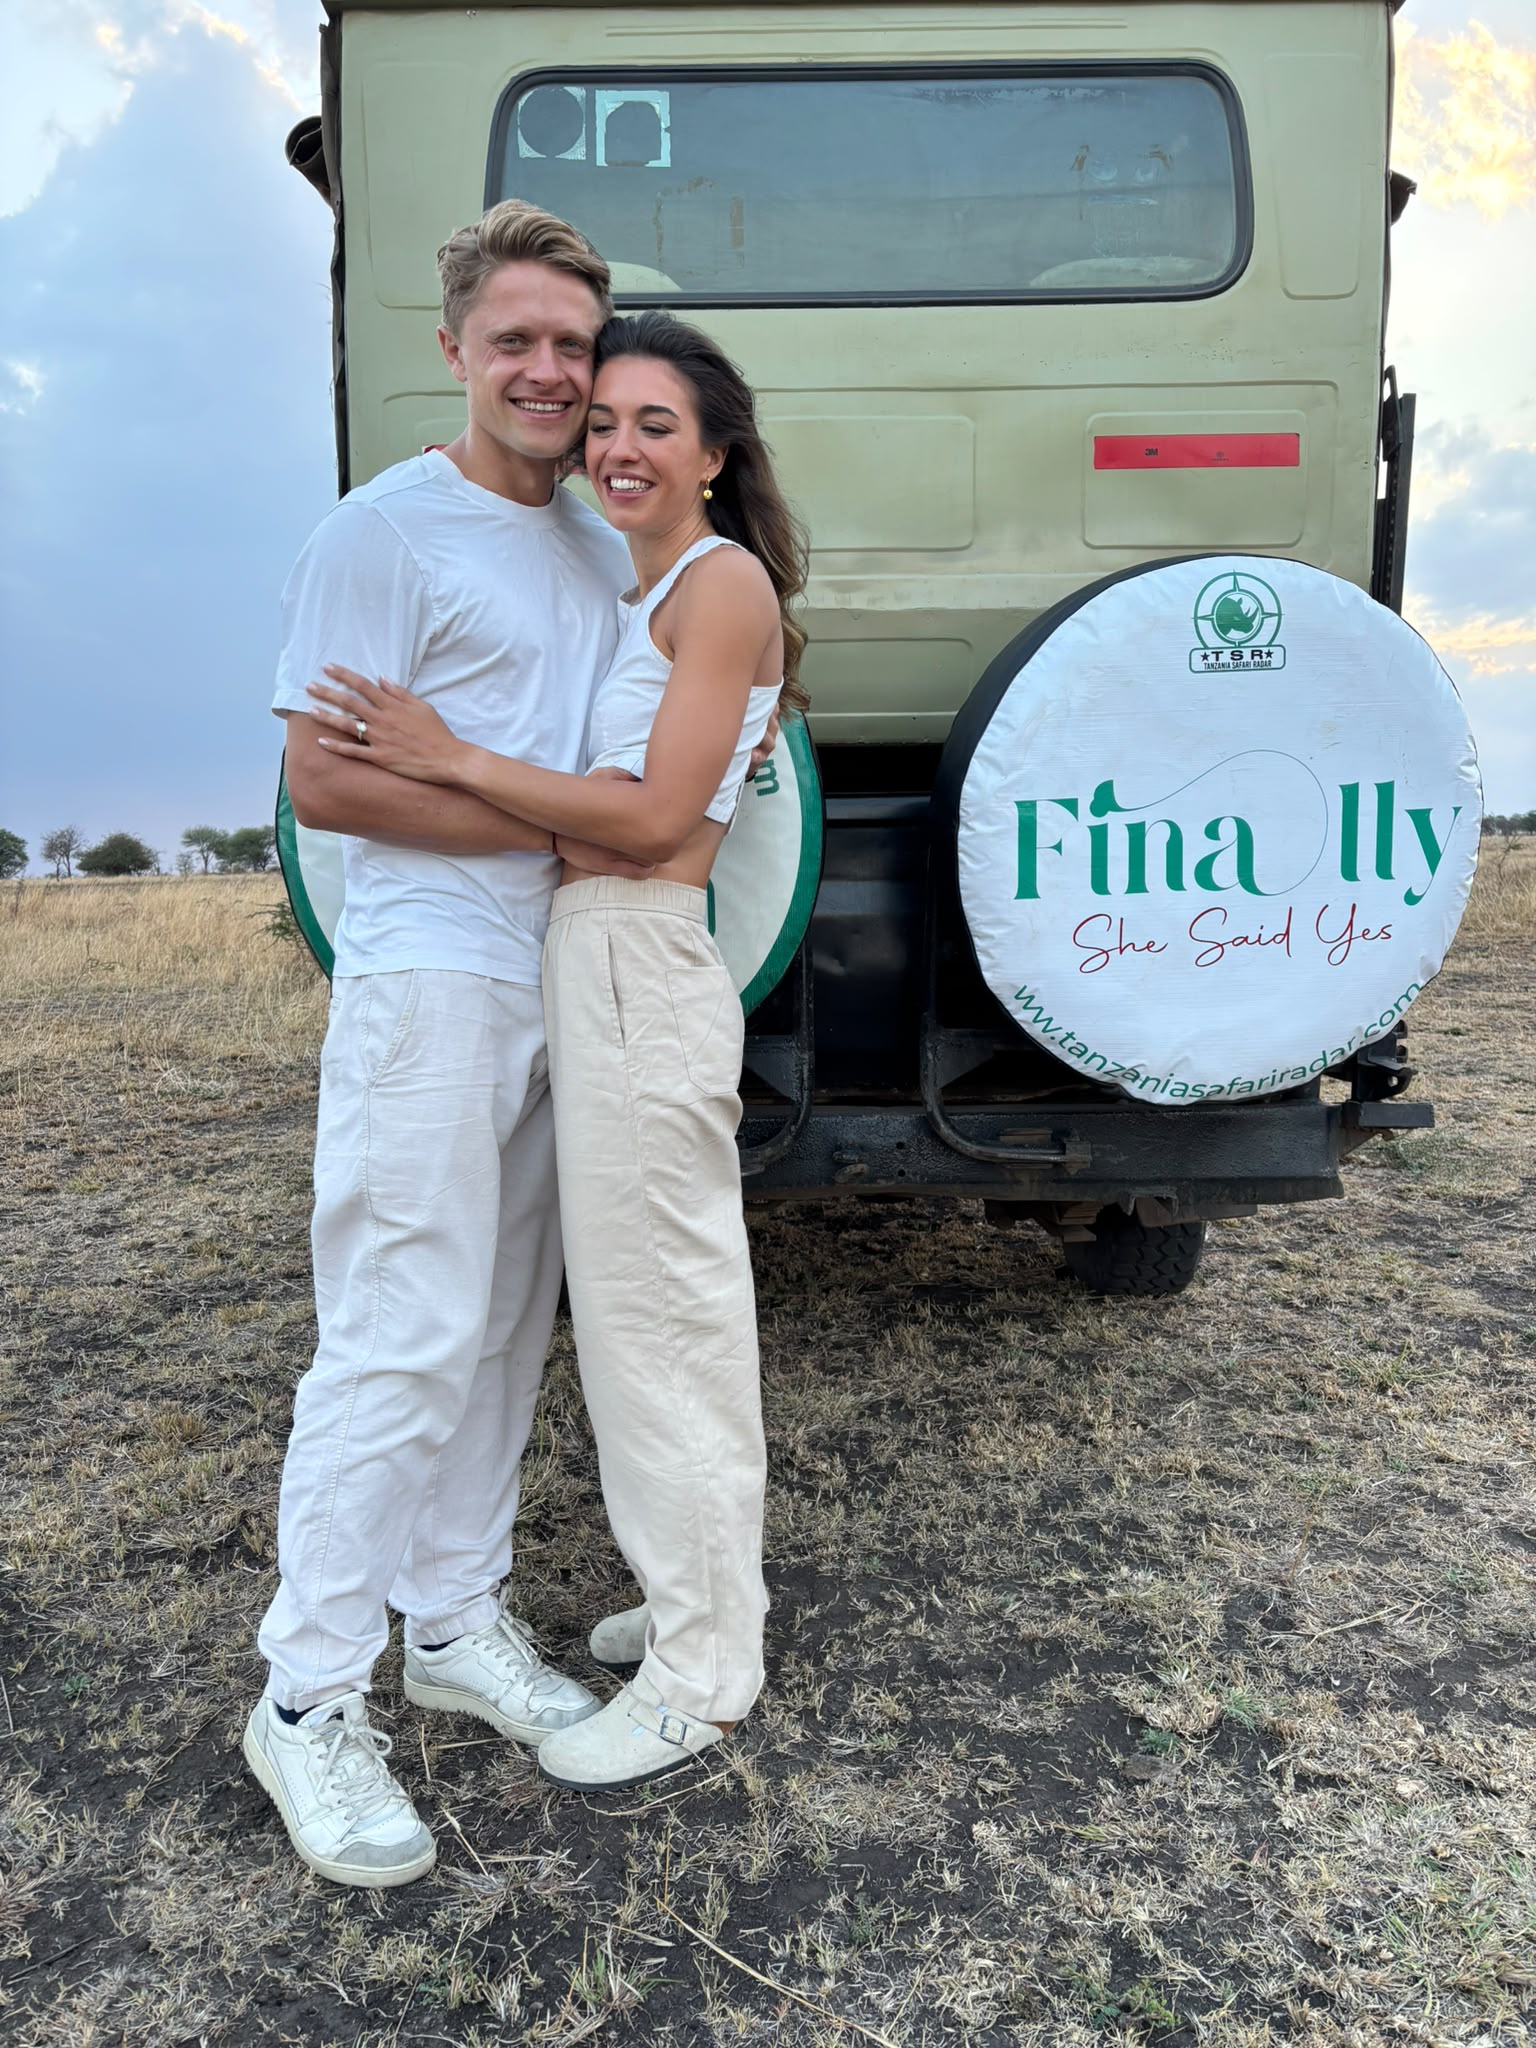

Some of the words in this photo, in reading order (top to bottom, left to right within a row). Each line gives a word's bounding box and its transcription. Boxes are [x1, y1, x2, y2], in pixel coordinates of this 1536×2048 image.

[1144, 448, 1158, 457] 3M
[1204, 661, 1231, 670] TANZANIA
[1232, 660, 1252, 669] SAFARI
[1253, 659, 1272, 668] RADAR
[1073, 913, 1168, 974] She
[1189, 906, 1293, 968] Said
[1315, 902, 1393, 967] Yes
